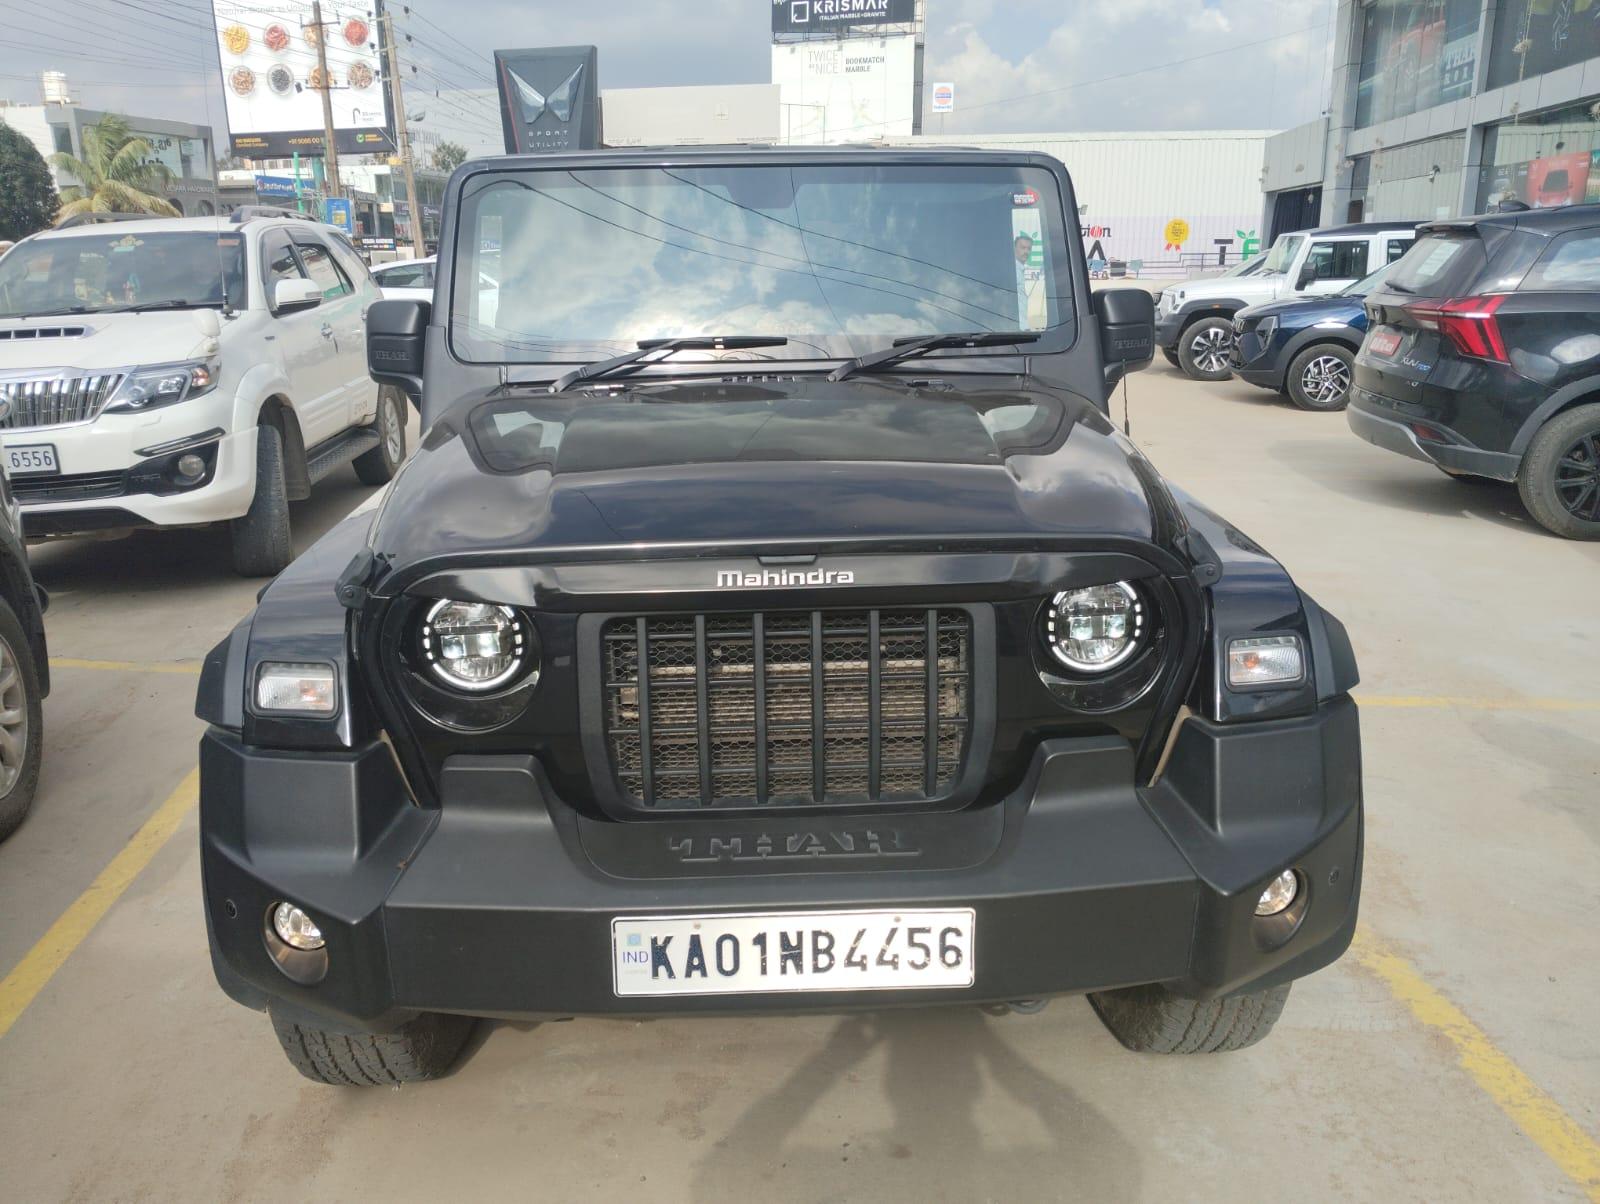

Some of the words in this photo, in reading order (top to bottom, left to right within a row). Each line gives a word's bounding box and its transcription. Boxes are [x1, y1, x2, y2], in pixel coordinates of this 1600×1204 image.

[813, 0, 888, 14] KRISMAR
[845, 56, 885, 65] BOOKMATCH
[845, 65, 871, 73] MARBLE
[717, 568, 854, 587] Mahindra
[622, 951, 649, 964] IND
[650, 926, 964, 980] KA01NB4456
